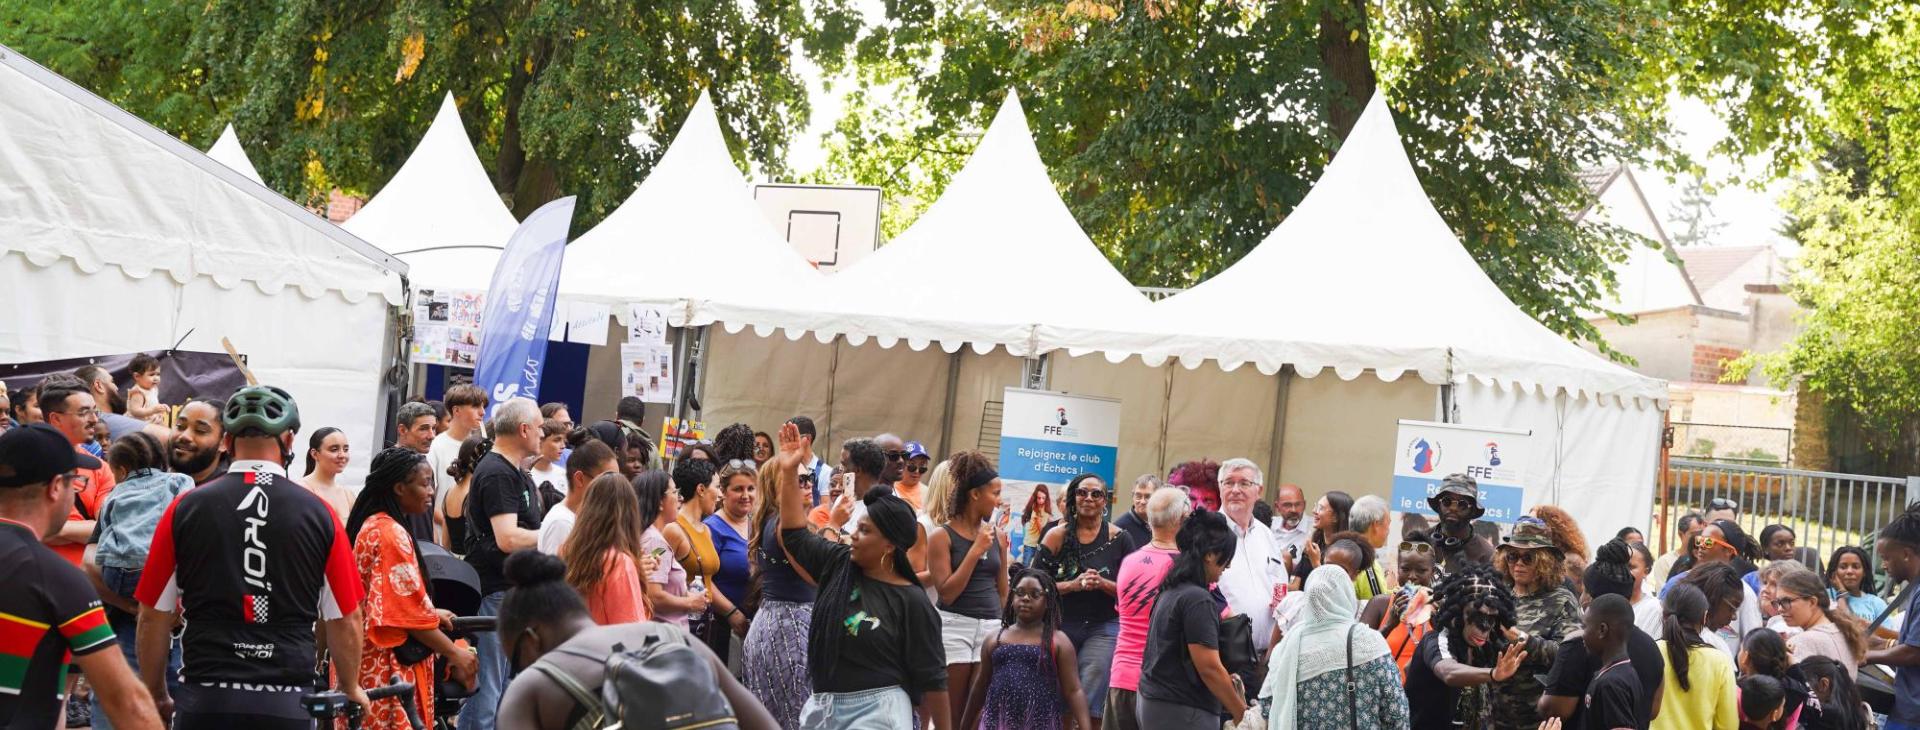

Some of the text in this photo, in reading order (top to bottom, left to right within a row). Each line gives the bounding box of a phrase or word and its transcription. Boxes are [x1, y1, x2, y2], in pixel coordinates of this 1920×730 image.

[1043, 425, 1062, 436] FFE
[1018, 447, 1100, 464] Rejoignez le club
[1034, 462, 1078, 475] d'Échecs
[1467, 466, 1493, 480] FFE
[1401, 497, 1412, 509] le
[233, 643, 275, 651] TRAINING
